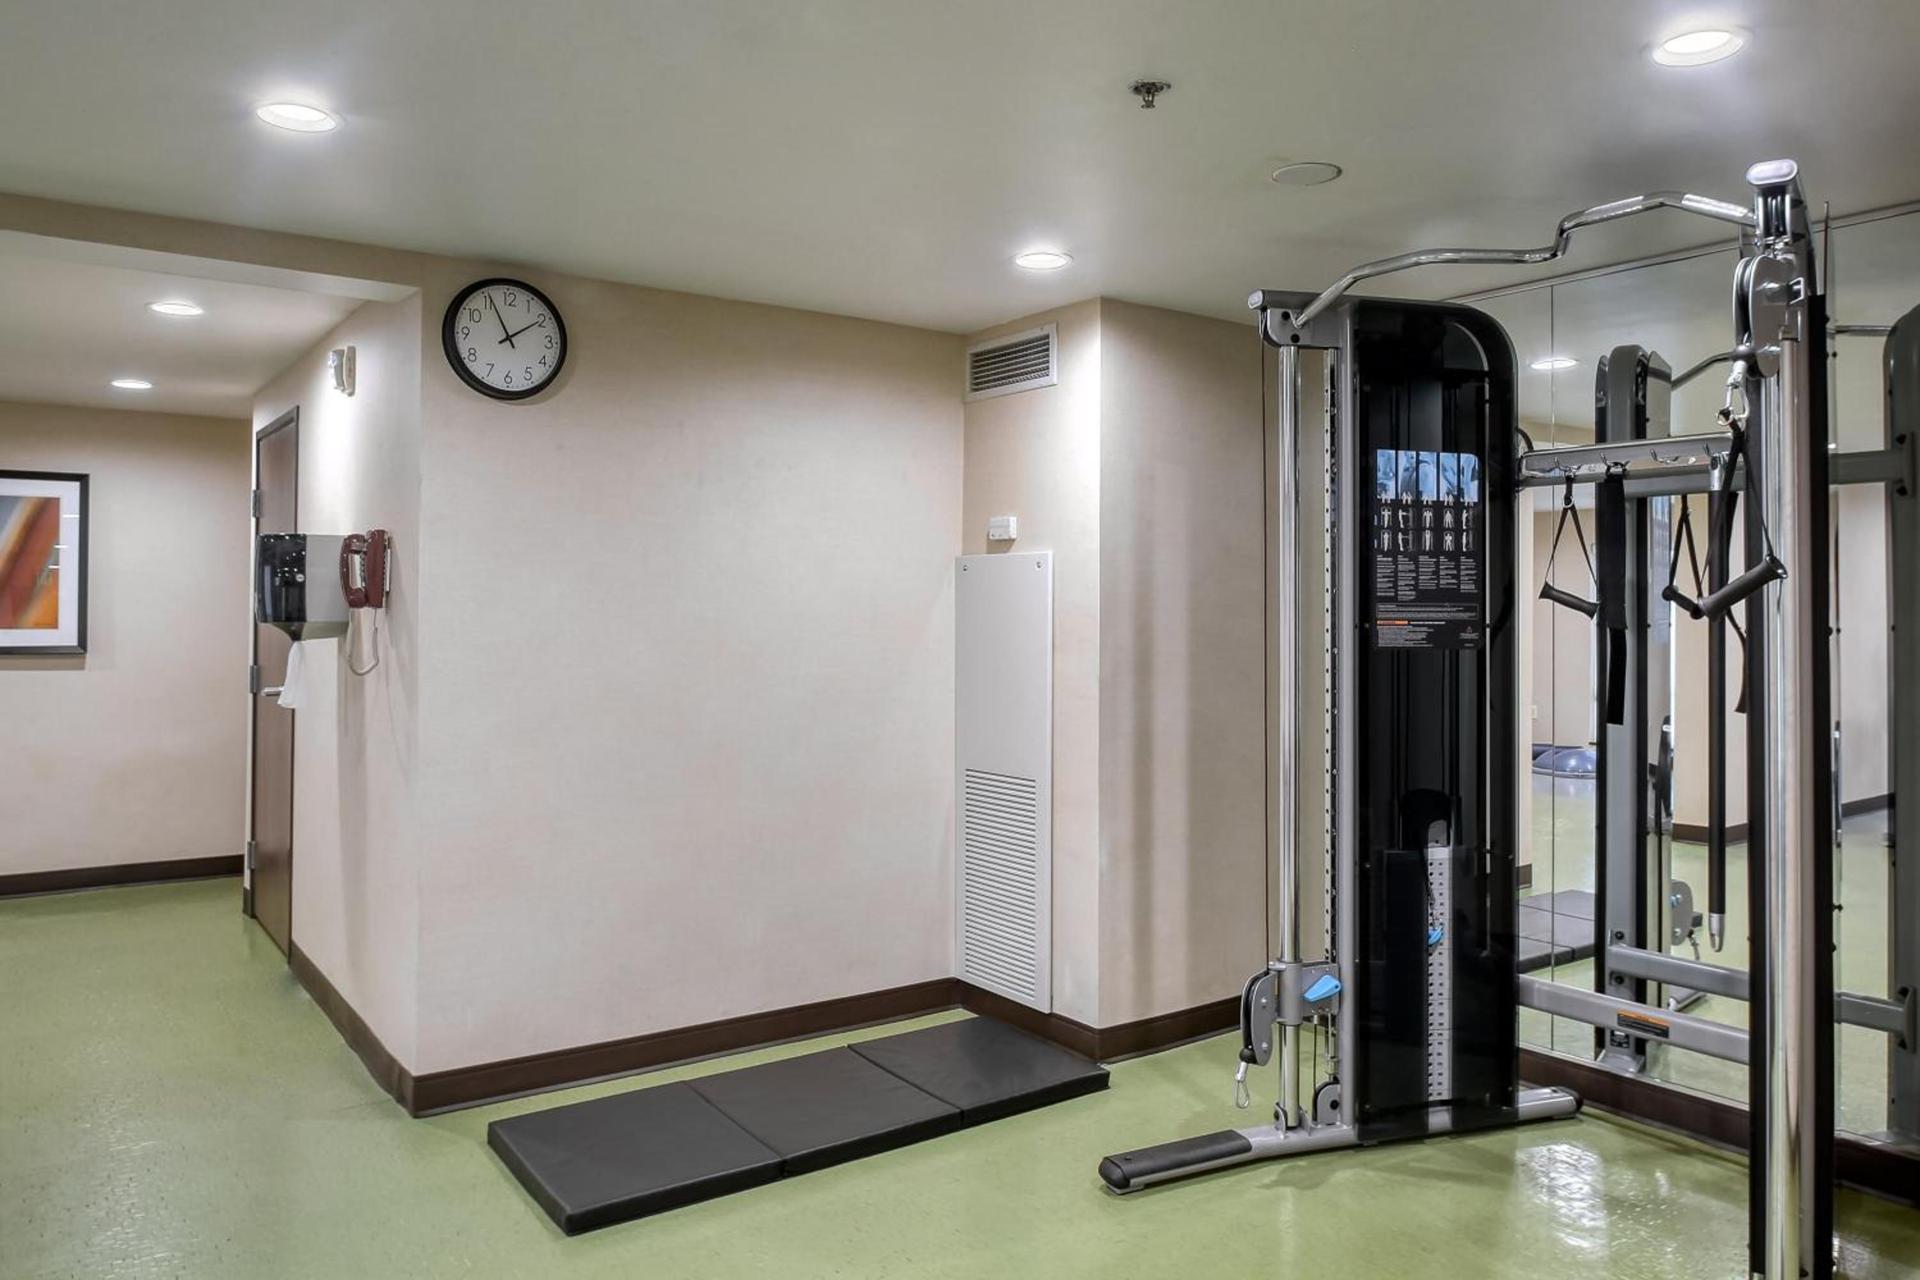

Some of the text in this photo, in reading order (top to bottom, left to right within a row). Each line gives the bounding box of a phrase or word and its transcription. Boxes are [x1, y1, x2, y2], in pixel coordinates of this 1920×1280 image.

[484, 294, 493, 311] 11
[503, 291, 517, 307] 12
[467, 308, 482, 323] 10
[536, 313, 546, 328] 2
[461, 326, 470, 341] 9
[544, 335, 554, 350] 3
[467, 347, 477, 362] 8
[538, 355, 547, 367] 4
[486, 363, 495, 378] 7
[503, 370, 513, 385] 6
[523, 366, 533, 381] 5
